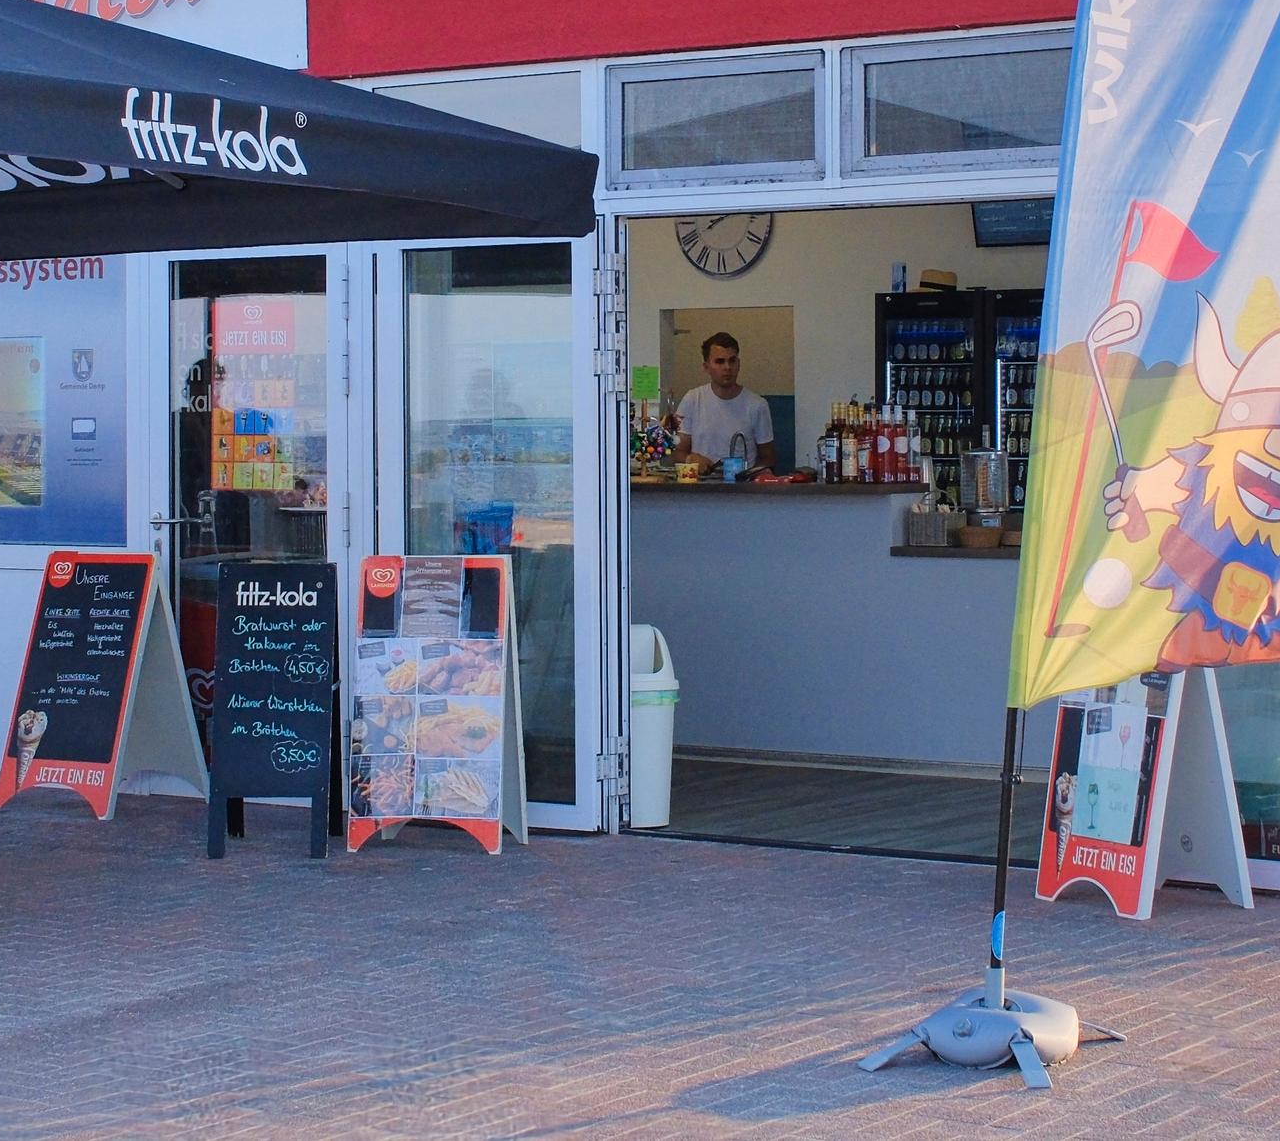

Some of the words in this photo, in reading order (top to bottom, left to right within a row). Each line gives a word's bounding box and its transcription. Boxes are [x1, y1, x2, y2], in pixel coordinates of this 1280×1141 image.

[121, 87, 308, 176] fritz-kola
[236, 581, 317, 606] fritz-kola
[232, 615, 297, 635] Bratwurst
[301, 619, 327, 632] oder
[252, 721, 298, 739] Brötchen
[35, 766, 66, 784] JETZT
[67, 768, 84, 785] EIN
[86, 770, 105, 787] EIS!
[1072, 845, 1099, 869] JETZT
[1100, 850, 1117, 872] EIN
[1118, 853, 1137, 877] EIS!
